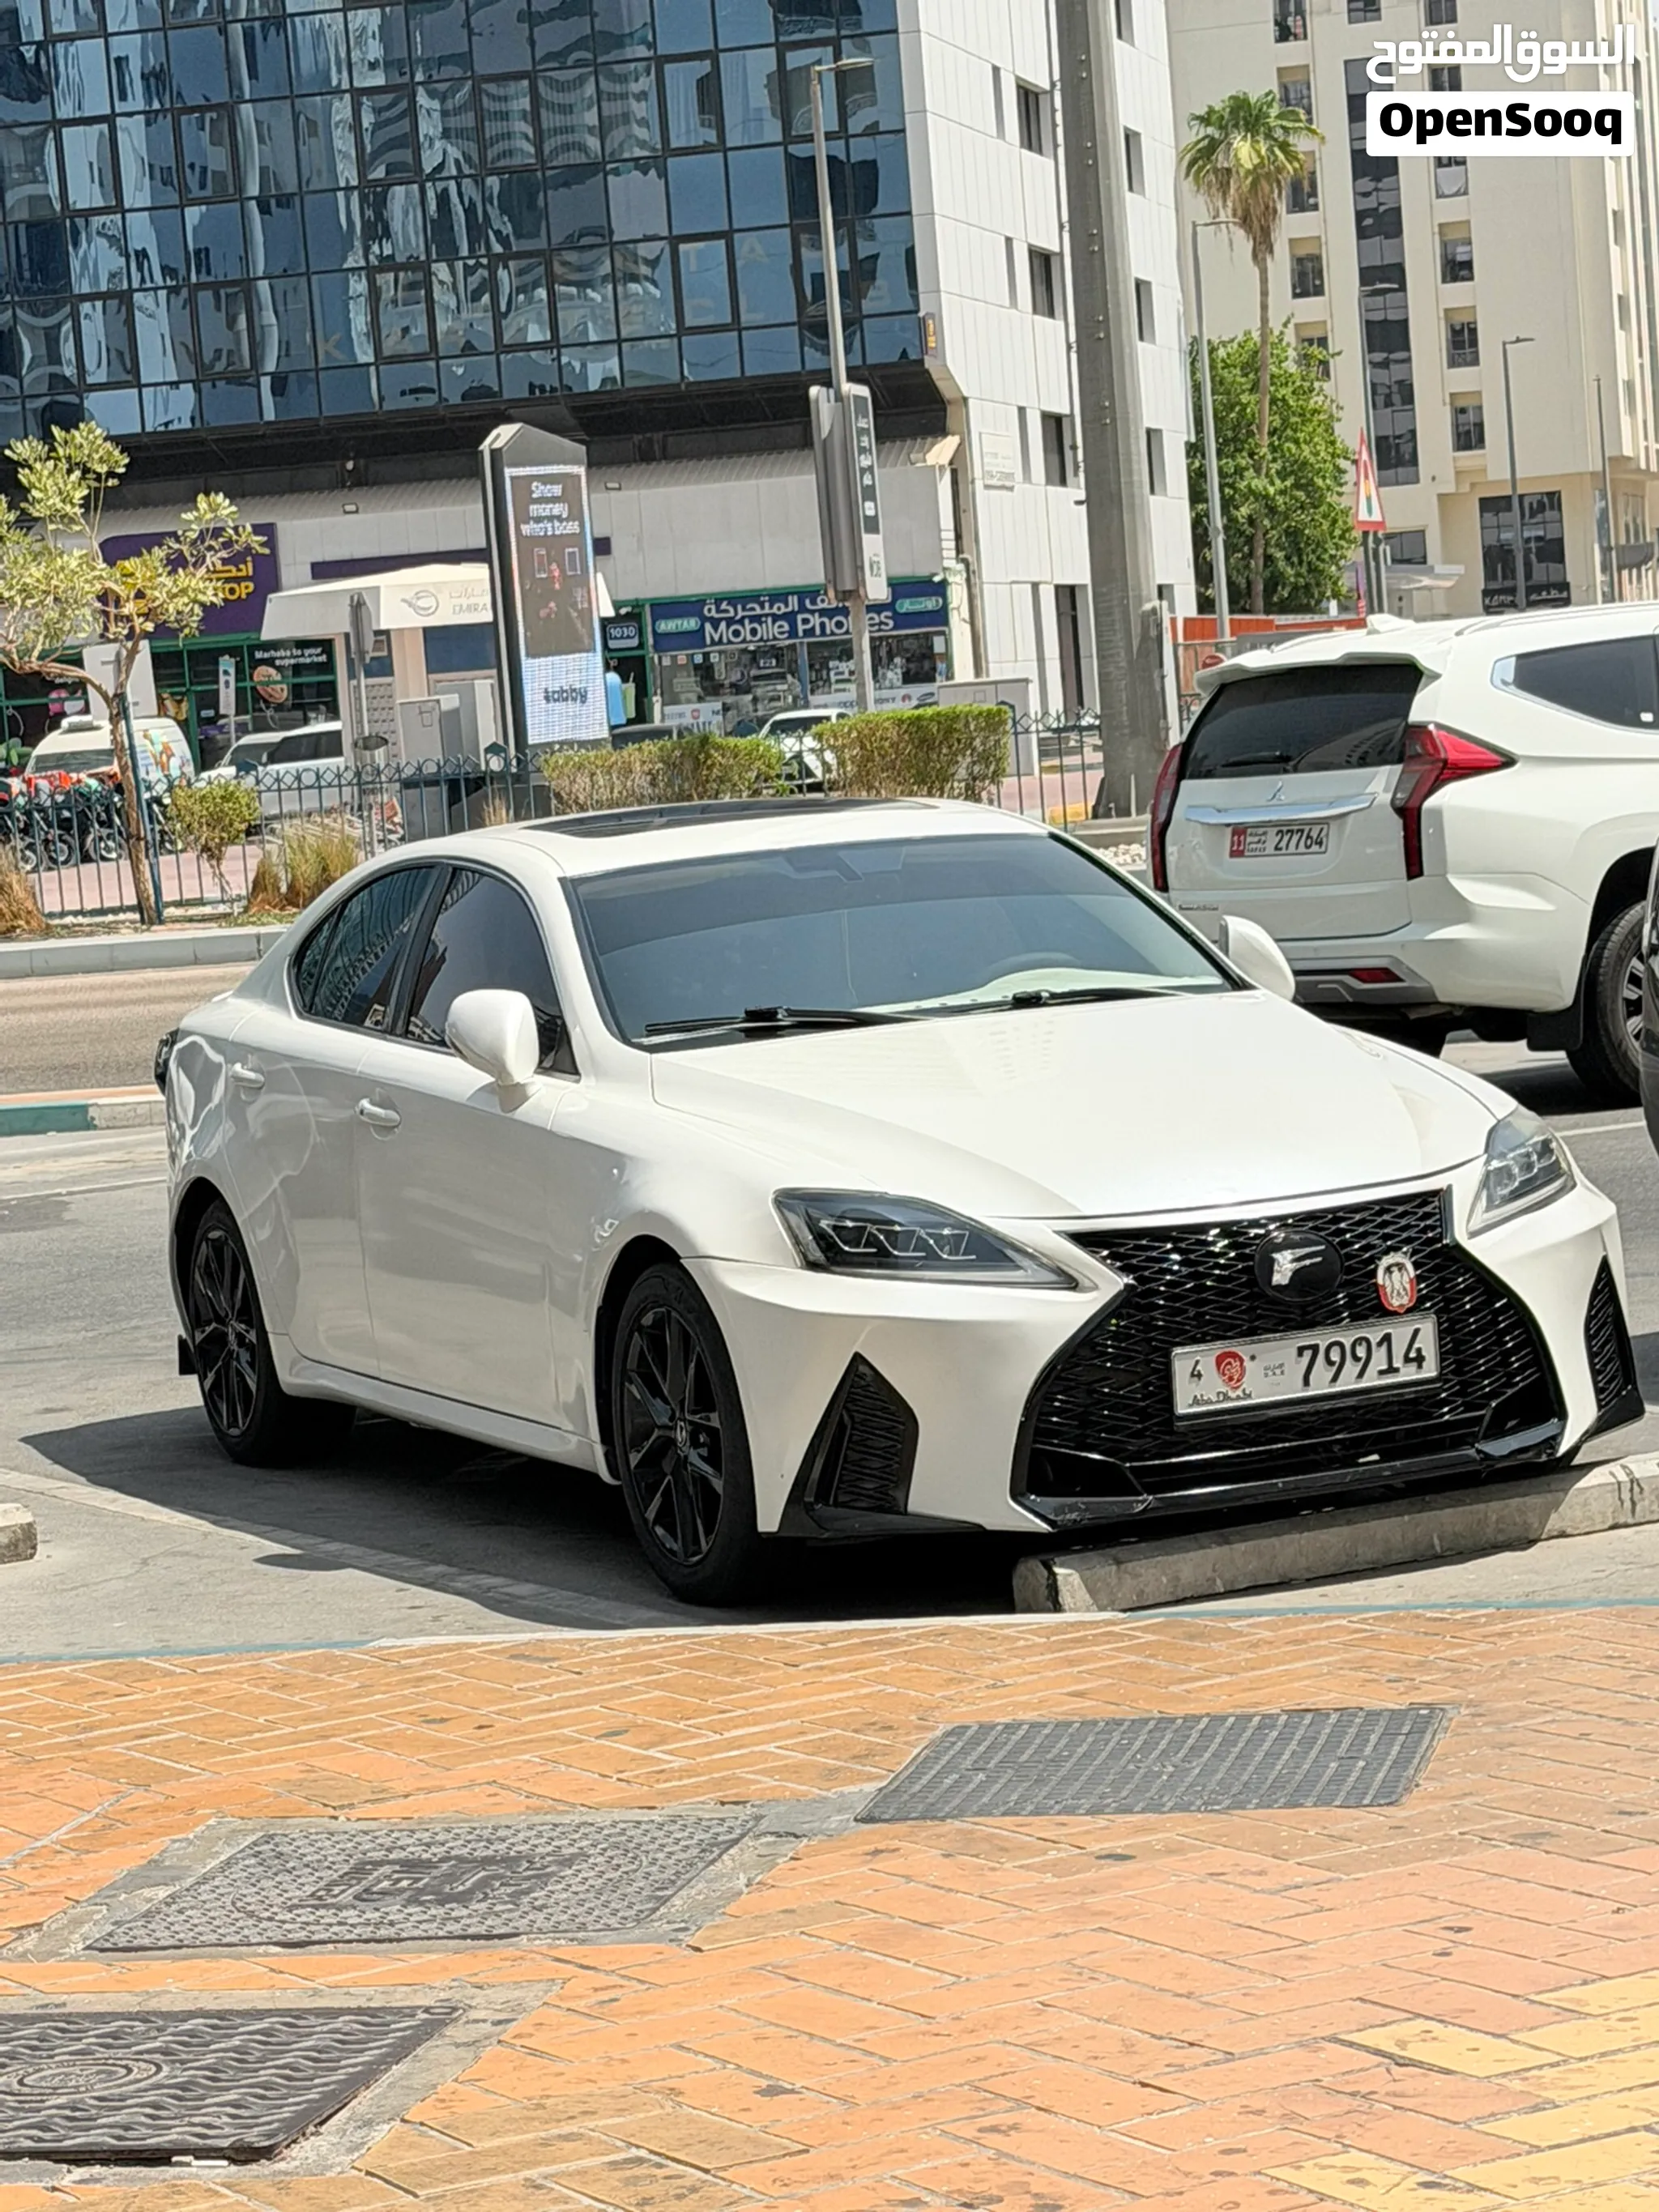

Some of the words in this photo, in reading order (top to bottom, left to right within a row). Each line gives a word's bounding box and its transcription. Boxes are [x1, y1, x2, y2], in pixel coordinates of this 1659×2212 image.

[531, 481, 562, 498] Show
[529, 502, 569, 518] money
[520, 520, 552, 536] who's
[703, 595, 797, 620] المتحركة
[610, 626, 635, 638] 1030
[659, 618, 697, 631] AWTAR
[704, 616, 790, 645] Mobile
[796, 611, 894, 637] Phoes
[254, 650, 292, 659] Marhaba
[292, 648, 302, 656] to
[303, 647, 323, 657] your
[275, 654, 327, 667] supermarket
[544, 684, 587, 705] tabby
[1231, 834, 1245, 850] 11
[1273, 827, 1324, 852] 27764
[1297, 1327, 1427, 1388] 79914
[1189, 1358, 1204, 1382] 4
